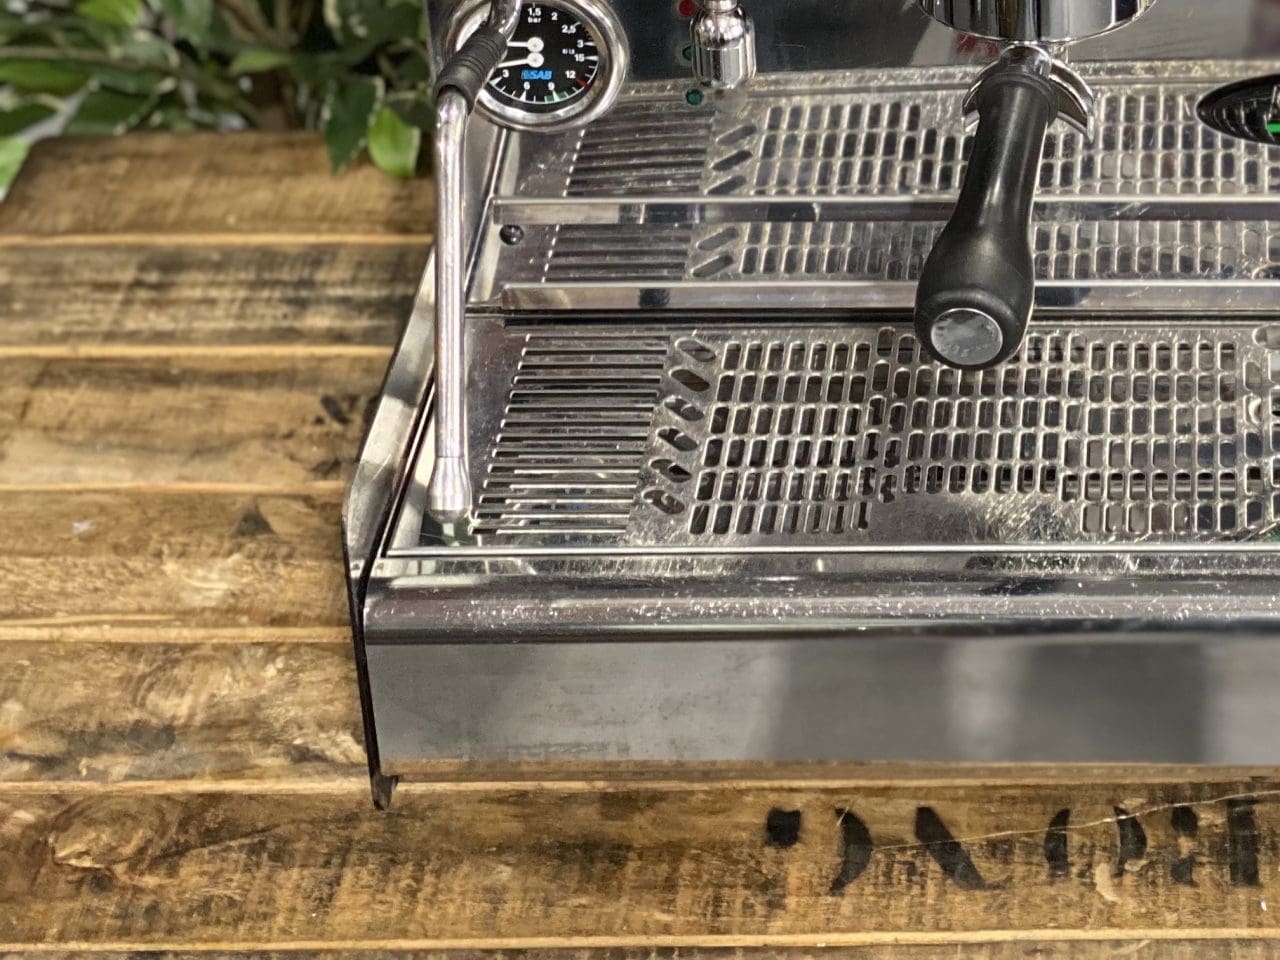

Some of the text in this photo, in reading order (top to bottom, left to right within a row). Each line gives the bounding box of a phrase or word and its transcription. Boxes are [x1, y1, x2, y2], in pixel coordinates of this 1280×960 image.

[551, 12, 558, 21] 2
[577, 39, 584, 48] 3
[575, 53, 585, 62] 15
[502, 69, 509, 78] 3
[565, 70, 576, 79] 12
